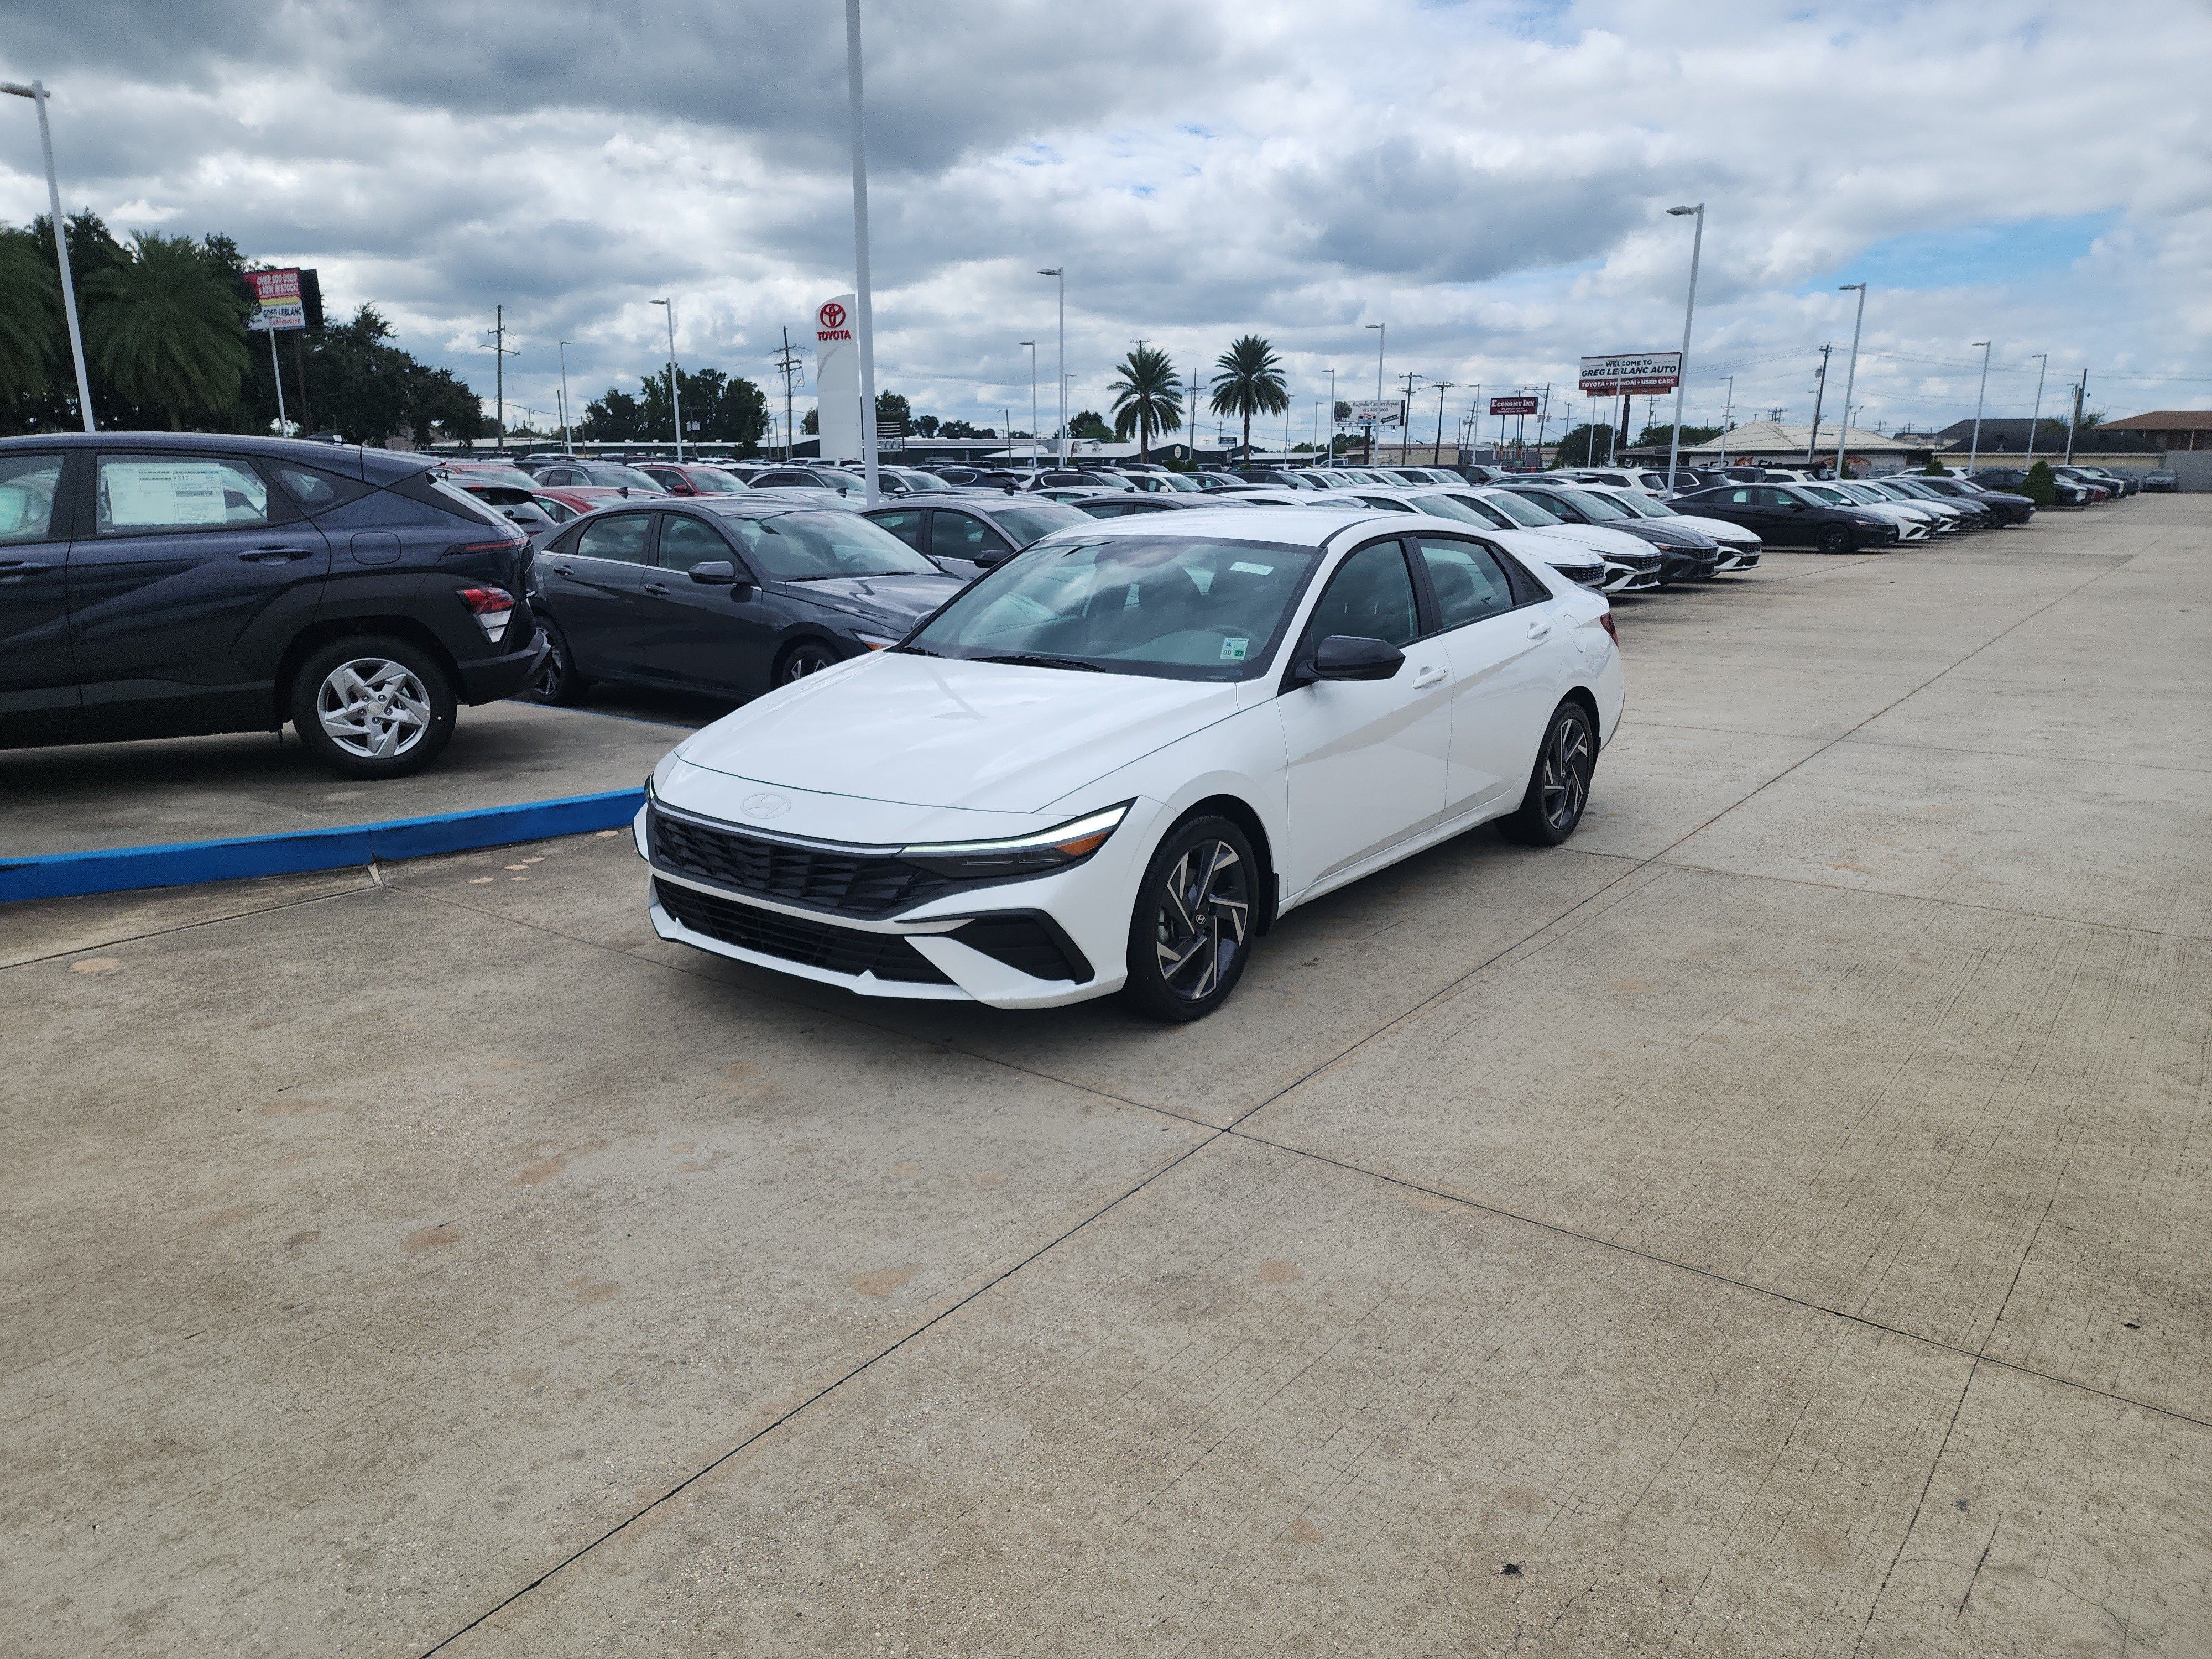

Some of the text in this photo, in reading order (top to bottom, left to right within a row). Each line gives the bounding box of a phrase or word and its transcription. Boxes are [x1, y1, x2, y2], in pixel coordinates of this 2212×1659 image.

[257, 275, 271, 286] OVER
[283, 273, 298, 283] USED
[262, 285, 274, 295] NEW
[274, 284, 280, 294] IN
[816, 330, 851, 341] TOYOTA
